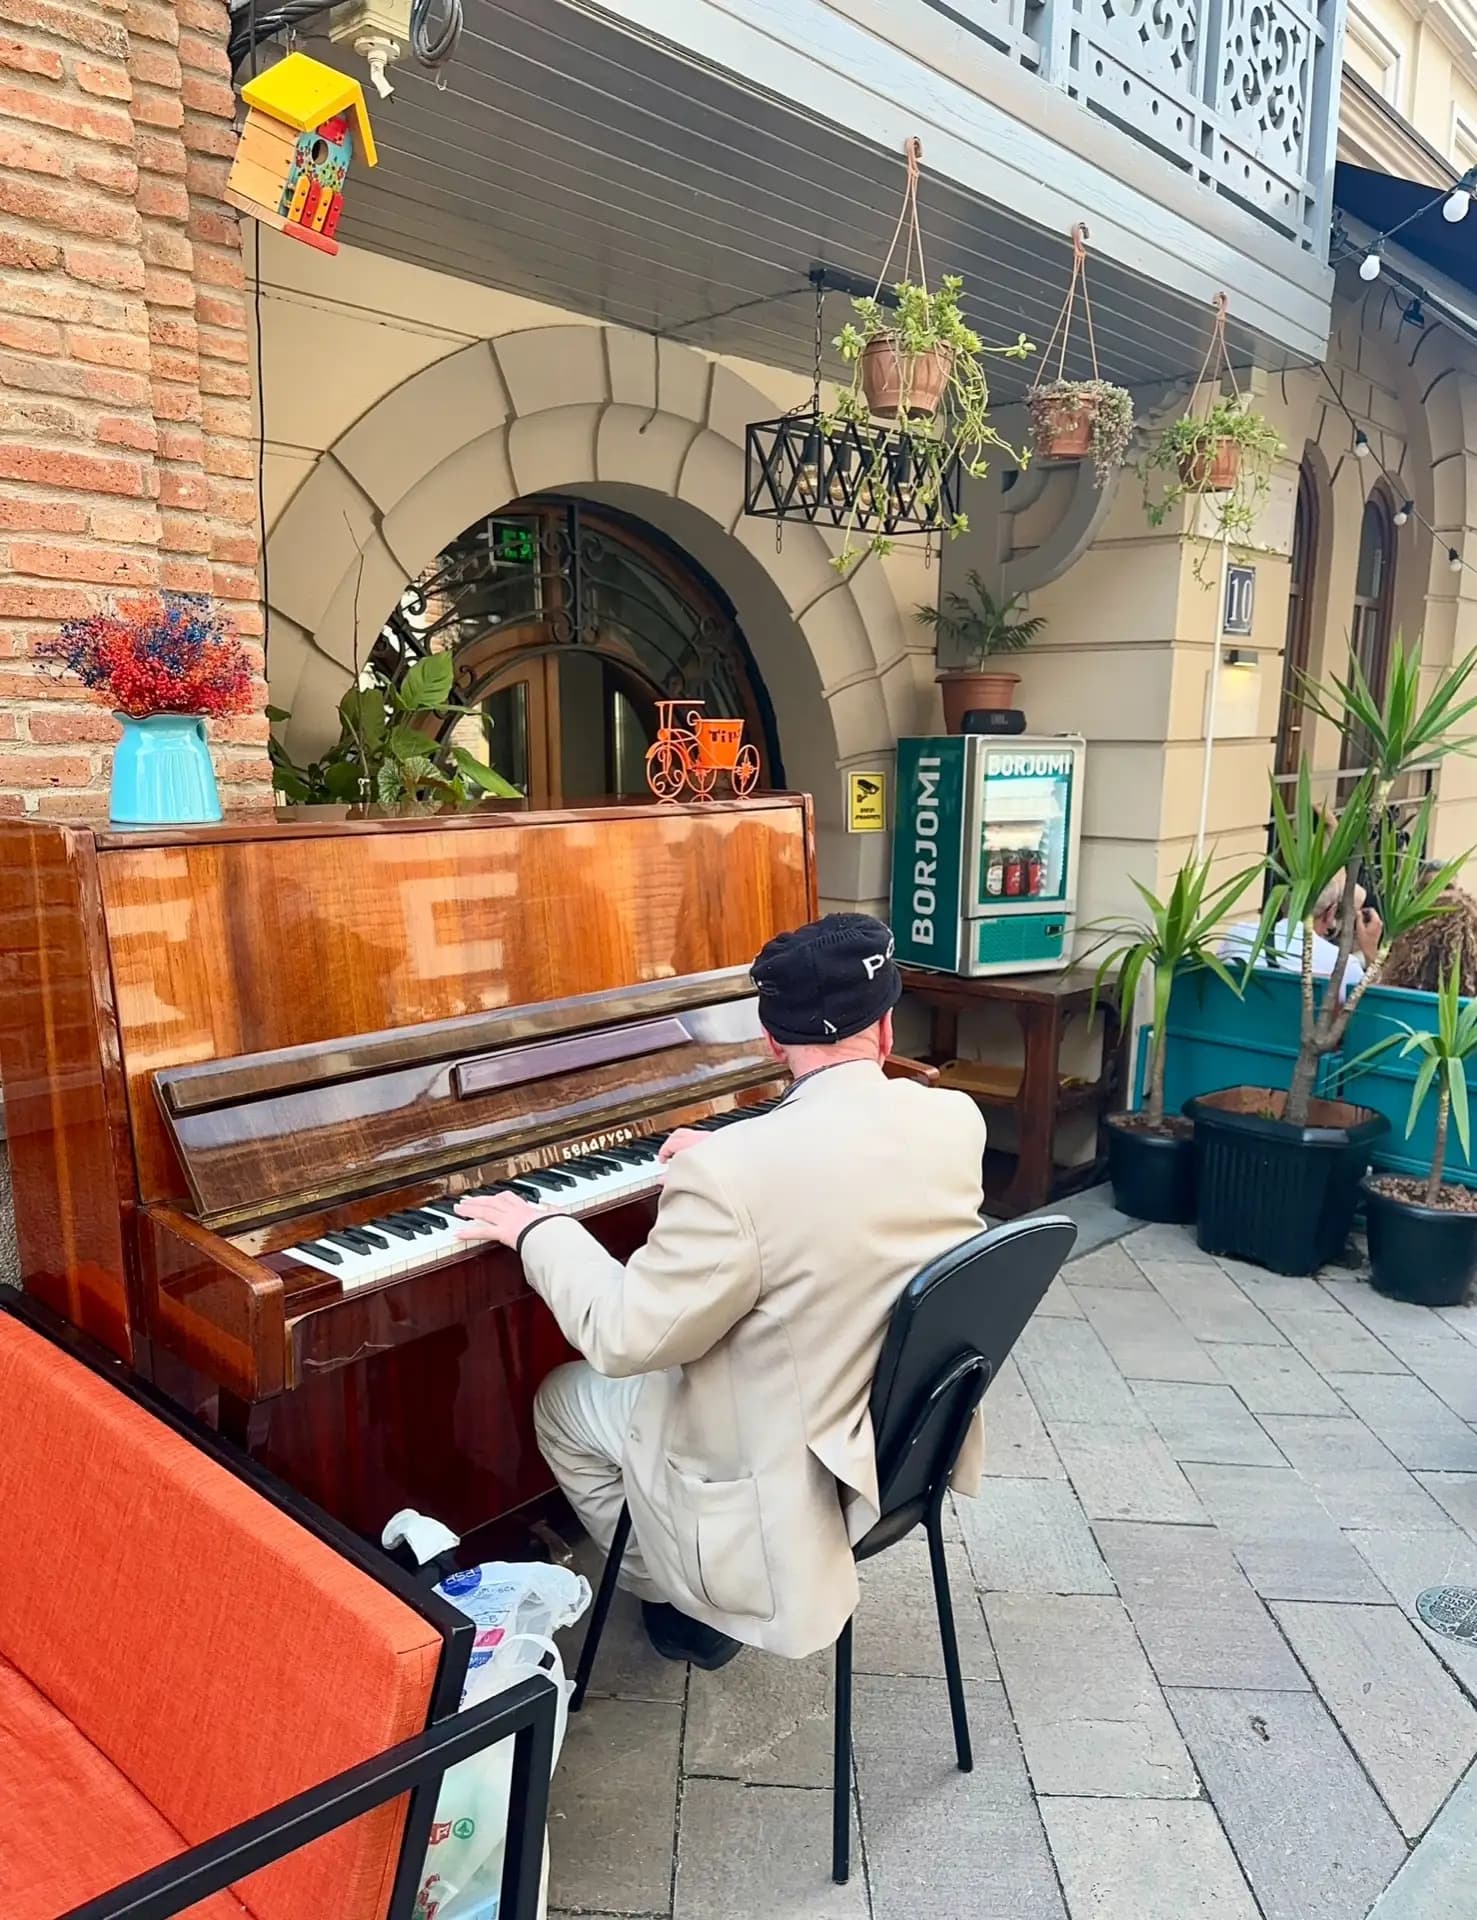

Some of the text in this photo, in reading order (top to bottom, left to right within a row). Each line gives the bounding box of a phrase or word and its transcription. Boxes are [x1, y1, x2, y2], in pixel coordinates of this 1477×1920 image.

[1229, 578, 1253, 622] 10
[987, 754, 1071, 777] BORJOMI
[911, 757, 941, 946] BORJOMI
[562, 1127, 634, 1161] БЕЛАРУСЬ
